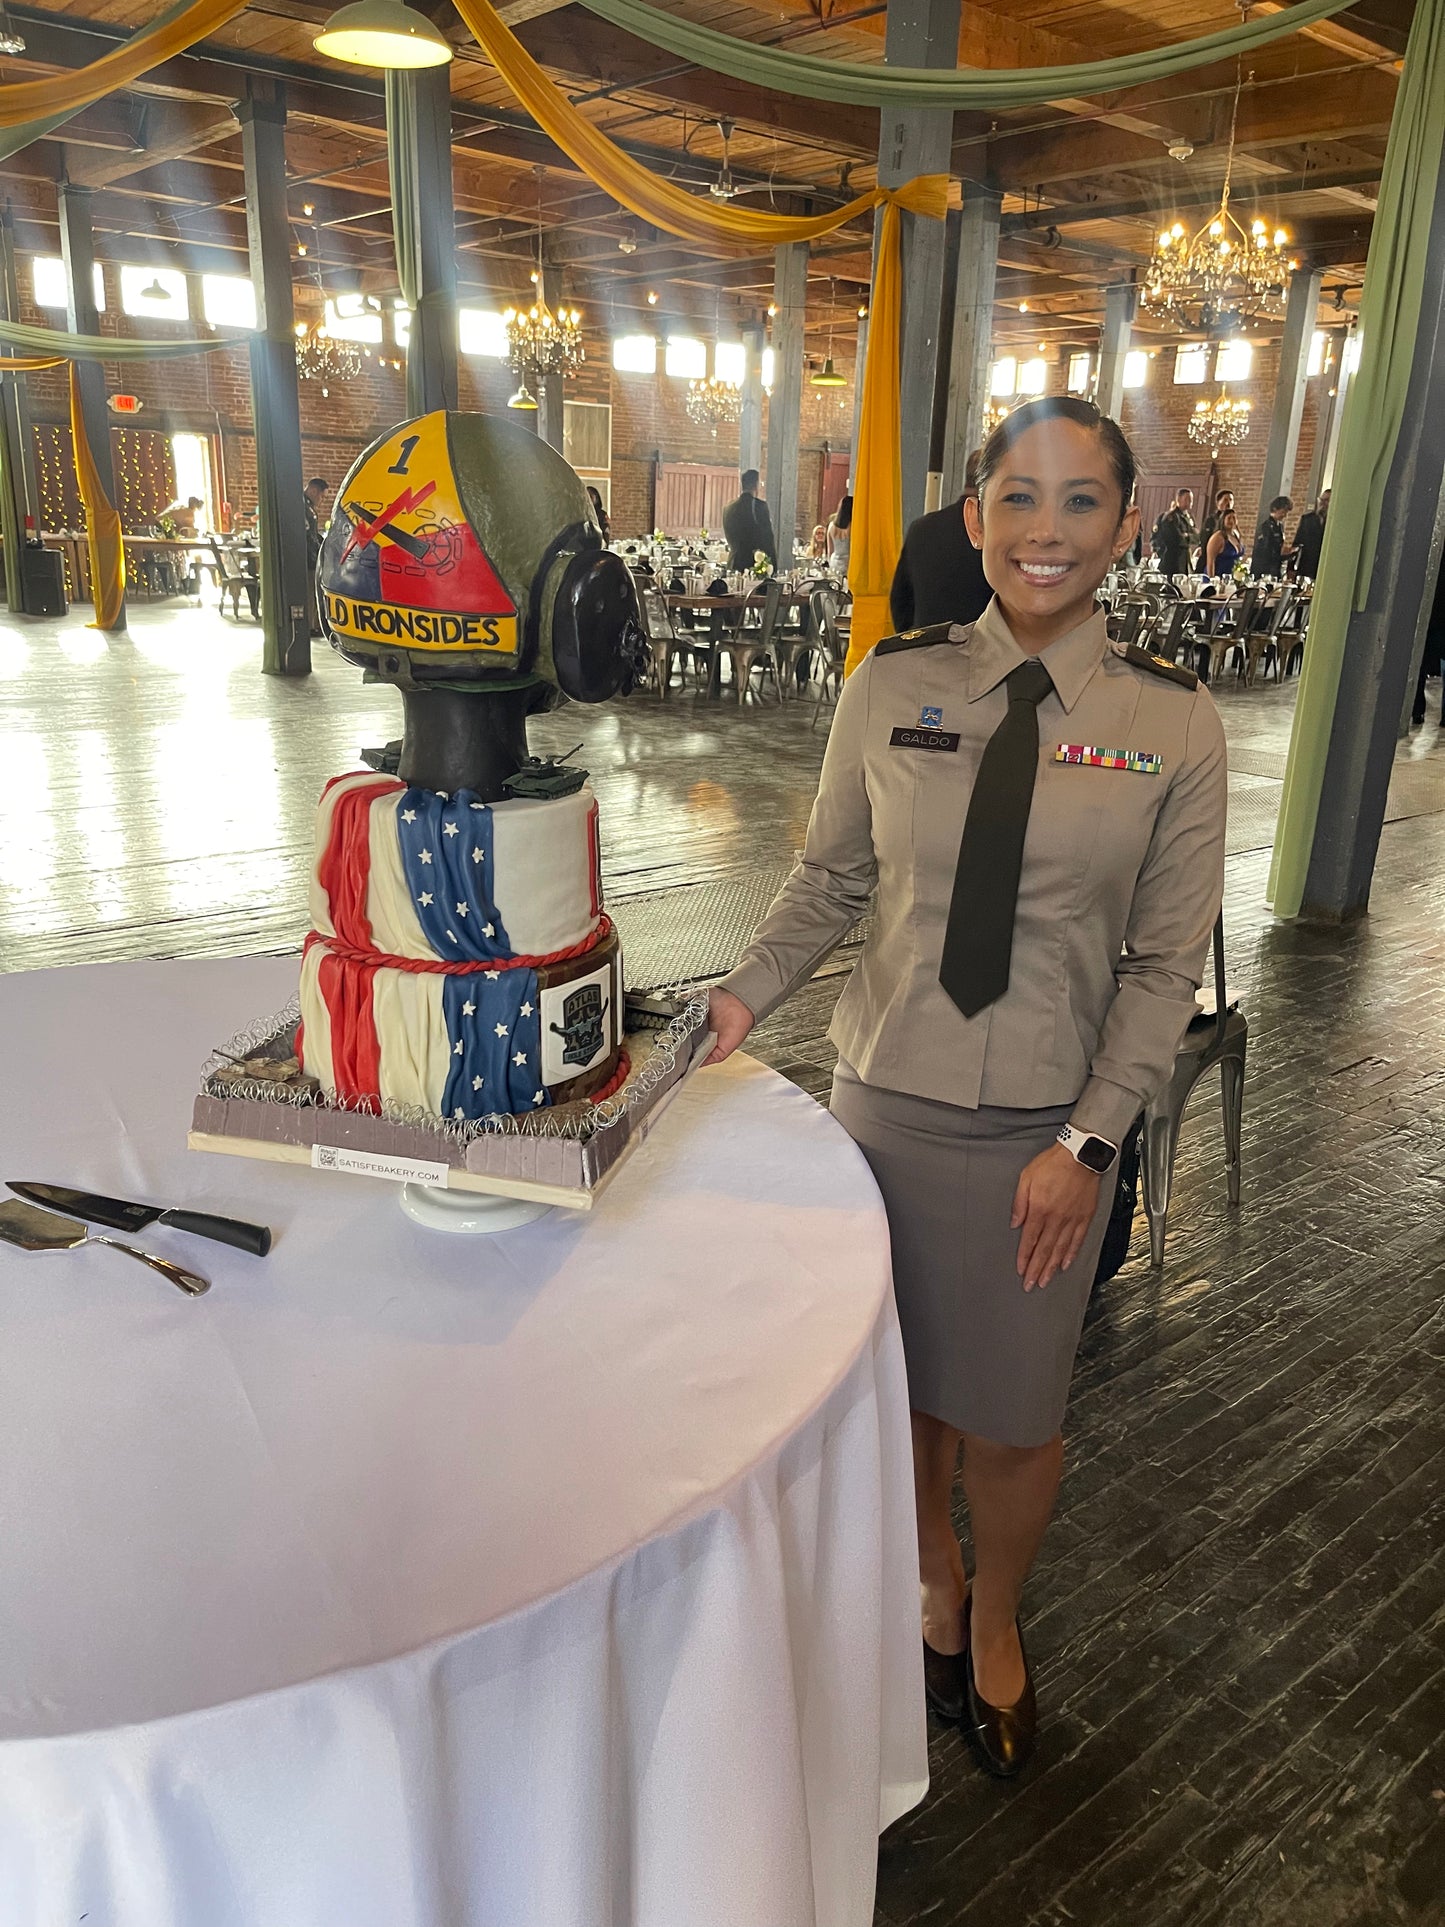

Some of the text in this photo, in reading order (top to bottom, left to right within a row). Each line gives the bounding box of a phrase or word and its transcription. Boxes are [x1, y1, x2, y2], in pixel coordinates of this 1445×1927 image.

[388, 435, 420, 475] 1
[324, 595, 501, 646] LD IRONSIDES
[901, 733, 950, 747] GALDO
[568, 991, 598, 1014] ATLAS
